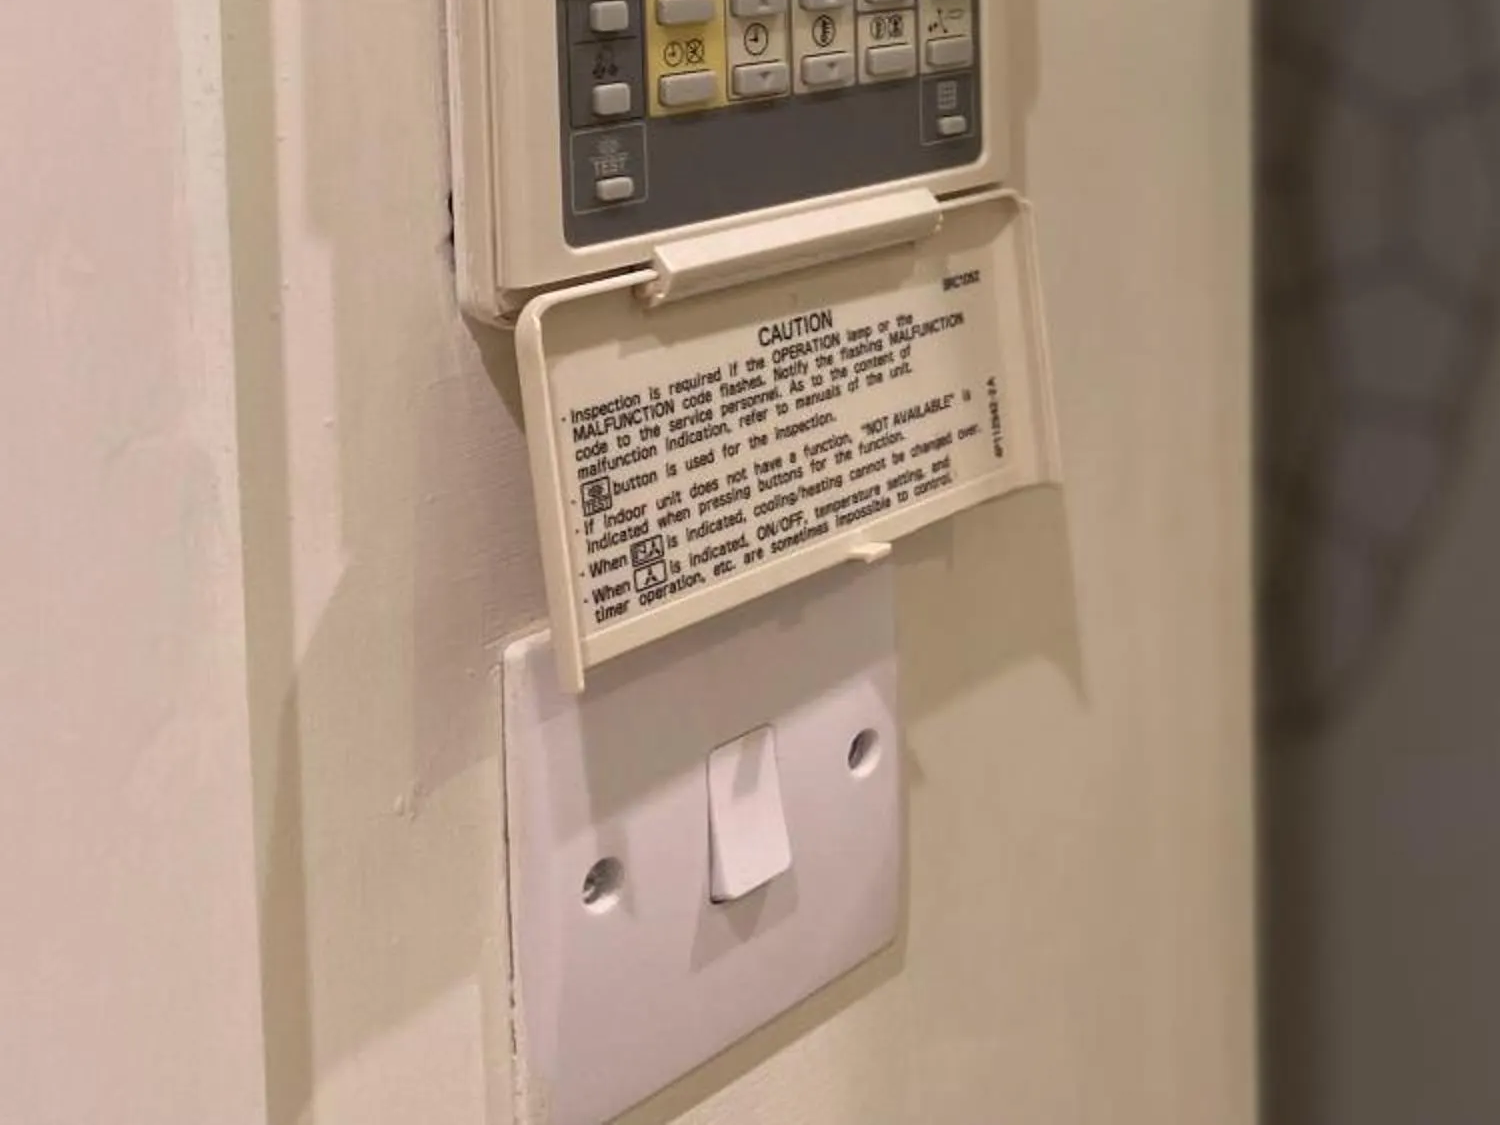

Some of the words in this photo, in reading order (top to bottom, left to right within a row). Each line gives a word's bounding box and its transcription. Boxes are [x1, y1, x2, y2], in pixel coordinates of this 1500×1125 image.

[571, 394, 641, 424] Inspection
[649, 386, 661, 400] is
[669, 367, 722, 395] required
[745, 357, 765, 372] the
[772, 332, 840, 363] OPERATION
[877, 320, 890, 333] or
[896, 314, 913, 327] the
[573, 400, 675, 443] MALFUNCTION
[682, 390, 713, 409] code
[773, 360, 808, 382] Notify
[815, 354, 833, 369] the
[840, 339, 882, 360] flashing
[888, 312, 964, 345] MALFUNCTION
[758, 309, 833, 347] CAUTION
[576, 442, 608, 462] code
[617, 435, 631, 449] to
[640, 425, 661, 441] the
[669, 408, 713, 432] service
[790, 379, 804, 394] As
[811, 374, 823, 387] to
[830, 366, 848, 381] the
[853, 351, 895, 373] content
[900, 344, 911, 359] of
[577, 444, 658, 479] malfunction
[740, 409, 768, 427] refer
[775, 402, 788, 416] to
[796, 385, 841, 409] manuals
[848, 377, 859, 393] of
[866, 372, 883, 386] the
[587, 520, 649, 554] indicated
[657, 507, 691, 528] when
[699, 485, 751, 516] pressing
[757, 467, 804, 492] buttons
[810, 457, 827, 473] for
[834, 449, 853, 465] the
[590, 554, 628, 578] When
[667, 534, 678, 549] is
[753, 475, 843, 517] cooling/heating
[850, 458, 886, 481] cannot
[892, 451, 905, 465] be
[910, 431, 953, 457] changed
[603, 504, 647, 529] indoor
[656, 491, 682, 510] unit
[689, 478, 718, 499] does
[726, 467, 748, 485] not
[754, 456, 782, 475] have
[789, 452, 797, 464] a
[613, 471, 657, 495] button
[666, 463, 677, 477] is
[685, 450, 715, 470] used
[722, 442, 741, 458] for
[748, 434, 768, 449] the
[592, 580, 631, 604] When
[670, 560, 681, 574] is
[814, 485, 881, 518] temperature
[931, 453, 951, 473] and
[595, 600, 630, 623] timer
[713, 561, 736, 576] etc.
[744, 547, 764, 564] are
[771, 522, 829, 554] sometimes
[835, 496, 892, 527] impossible
[897, 490, 908, 504] to
